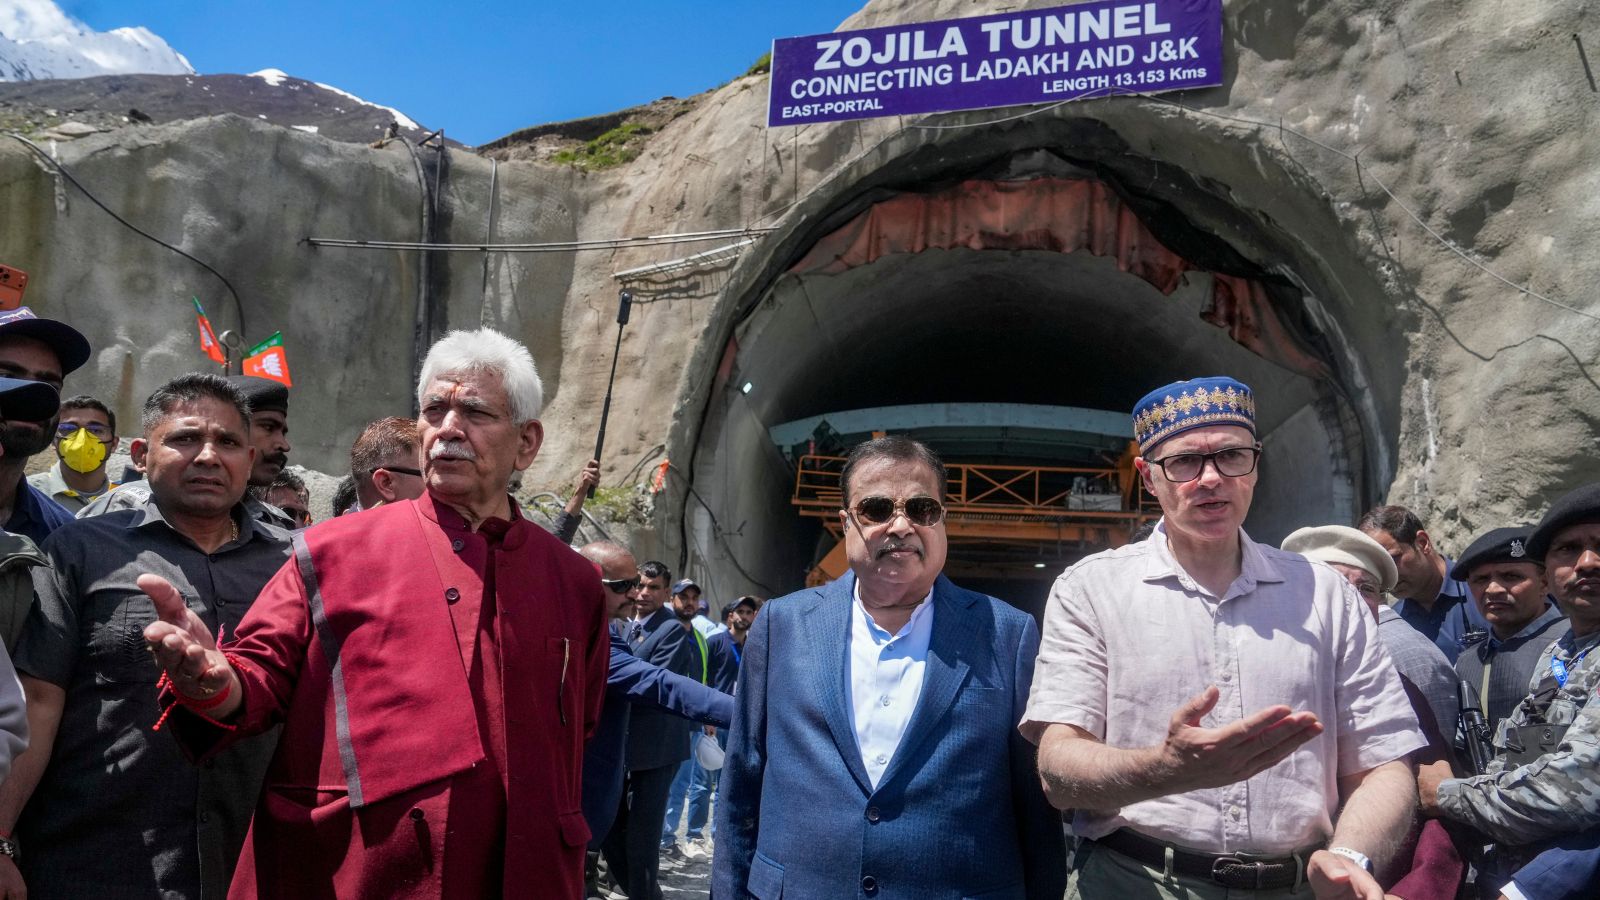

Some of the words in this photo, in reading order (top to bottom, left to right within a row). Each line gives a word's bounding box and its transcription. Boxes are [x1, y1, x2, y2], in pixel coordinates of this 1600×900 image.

[813, 26, 969, 71] ZOJILA
[981, 2, 1171, 53] TUNNEL
[790, 63, 953, 99] CONNECTING
[960, 51, 1069, 83] LADAKH
[1075, 44, 1135, 71] AND
[1142, 36, 1199, 64] J&K
[1042, 75, 1110, 94] LENGTH
[1114, 70, 1165, 87] 13.153
[1169, 67, 1207, 81] Kms
[782, 98, 883, 119] EAST-PORTAL
